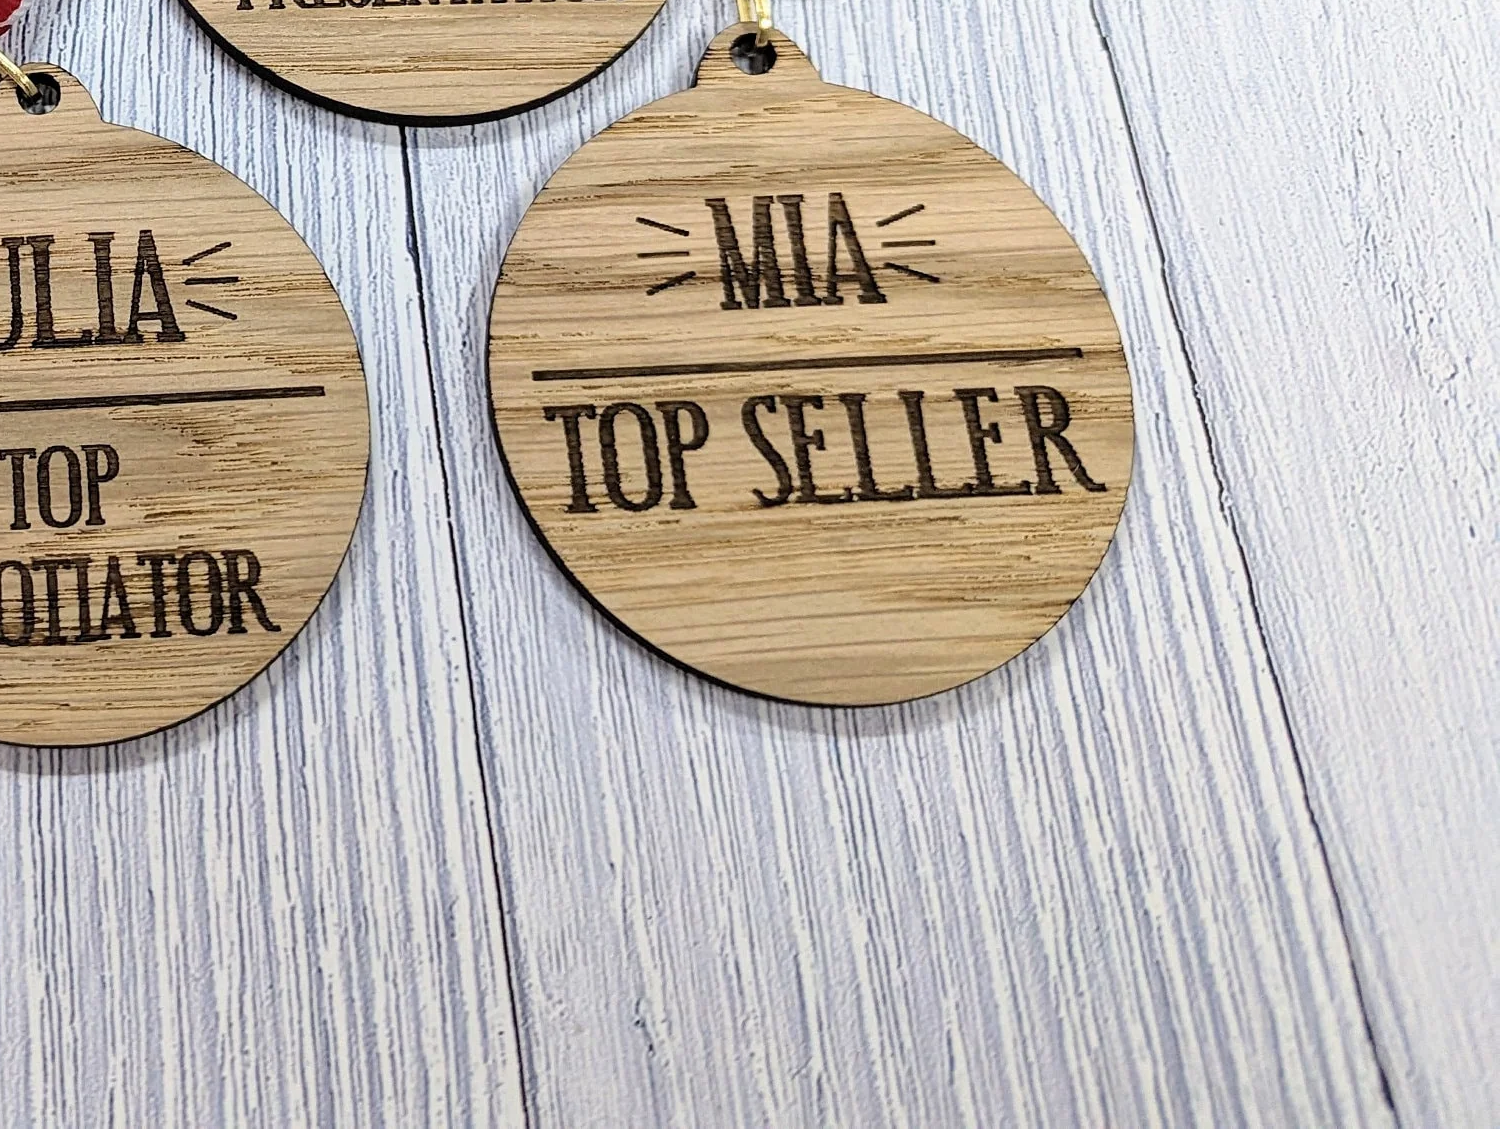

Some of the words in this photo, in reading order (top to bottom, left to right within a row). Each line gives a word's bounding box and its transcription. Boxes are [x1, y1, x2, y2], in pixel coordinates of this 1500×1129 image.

[704, 192, 888, 310] MIA
[0, 445, 120, 531] TOP
[543, 400, 709, 514] TOP
[741, 385, 1107, 508] SELLER
